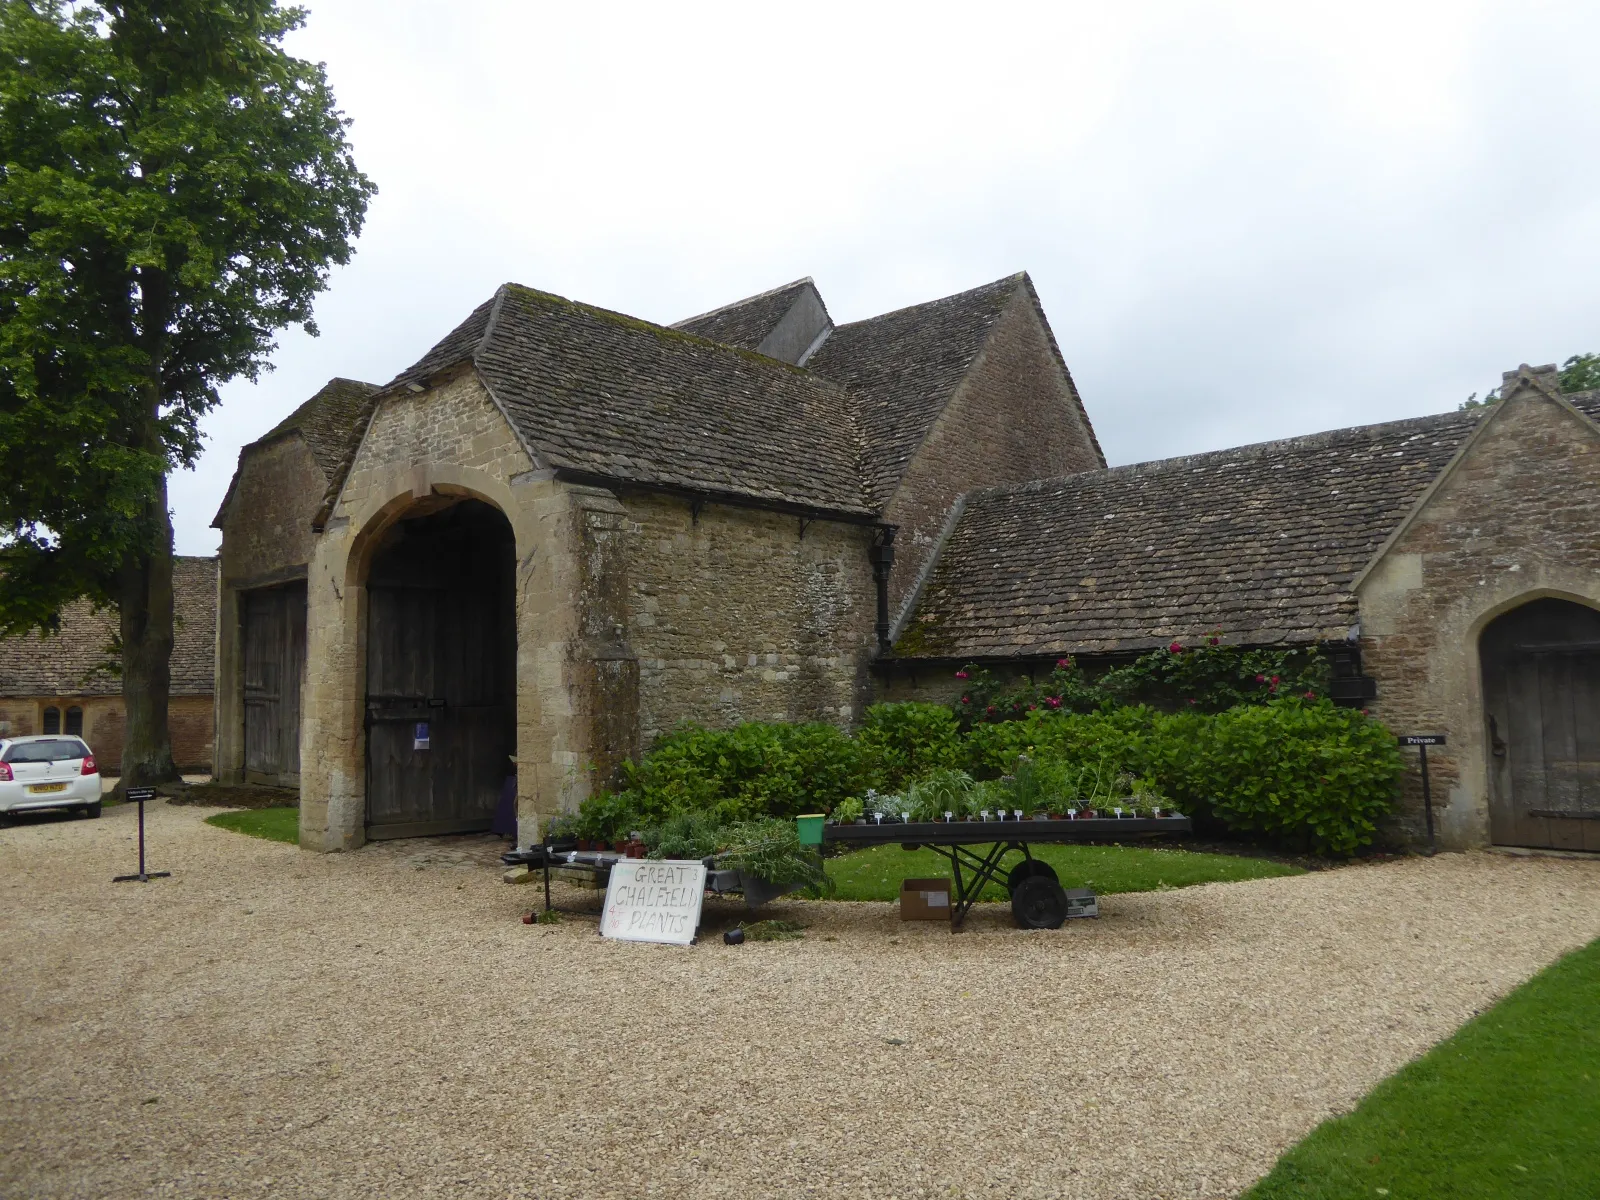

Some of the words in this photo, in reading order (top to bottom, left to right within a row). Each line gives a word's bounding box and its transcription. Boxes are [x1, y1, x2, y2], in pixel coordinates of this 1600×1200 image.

[635, 866, 688, 884] GREAT
[615, 886, 698, 908] CHALFIELD
[627, 911, 689, 933] PLANTS
